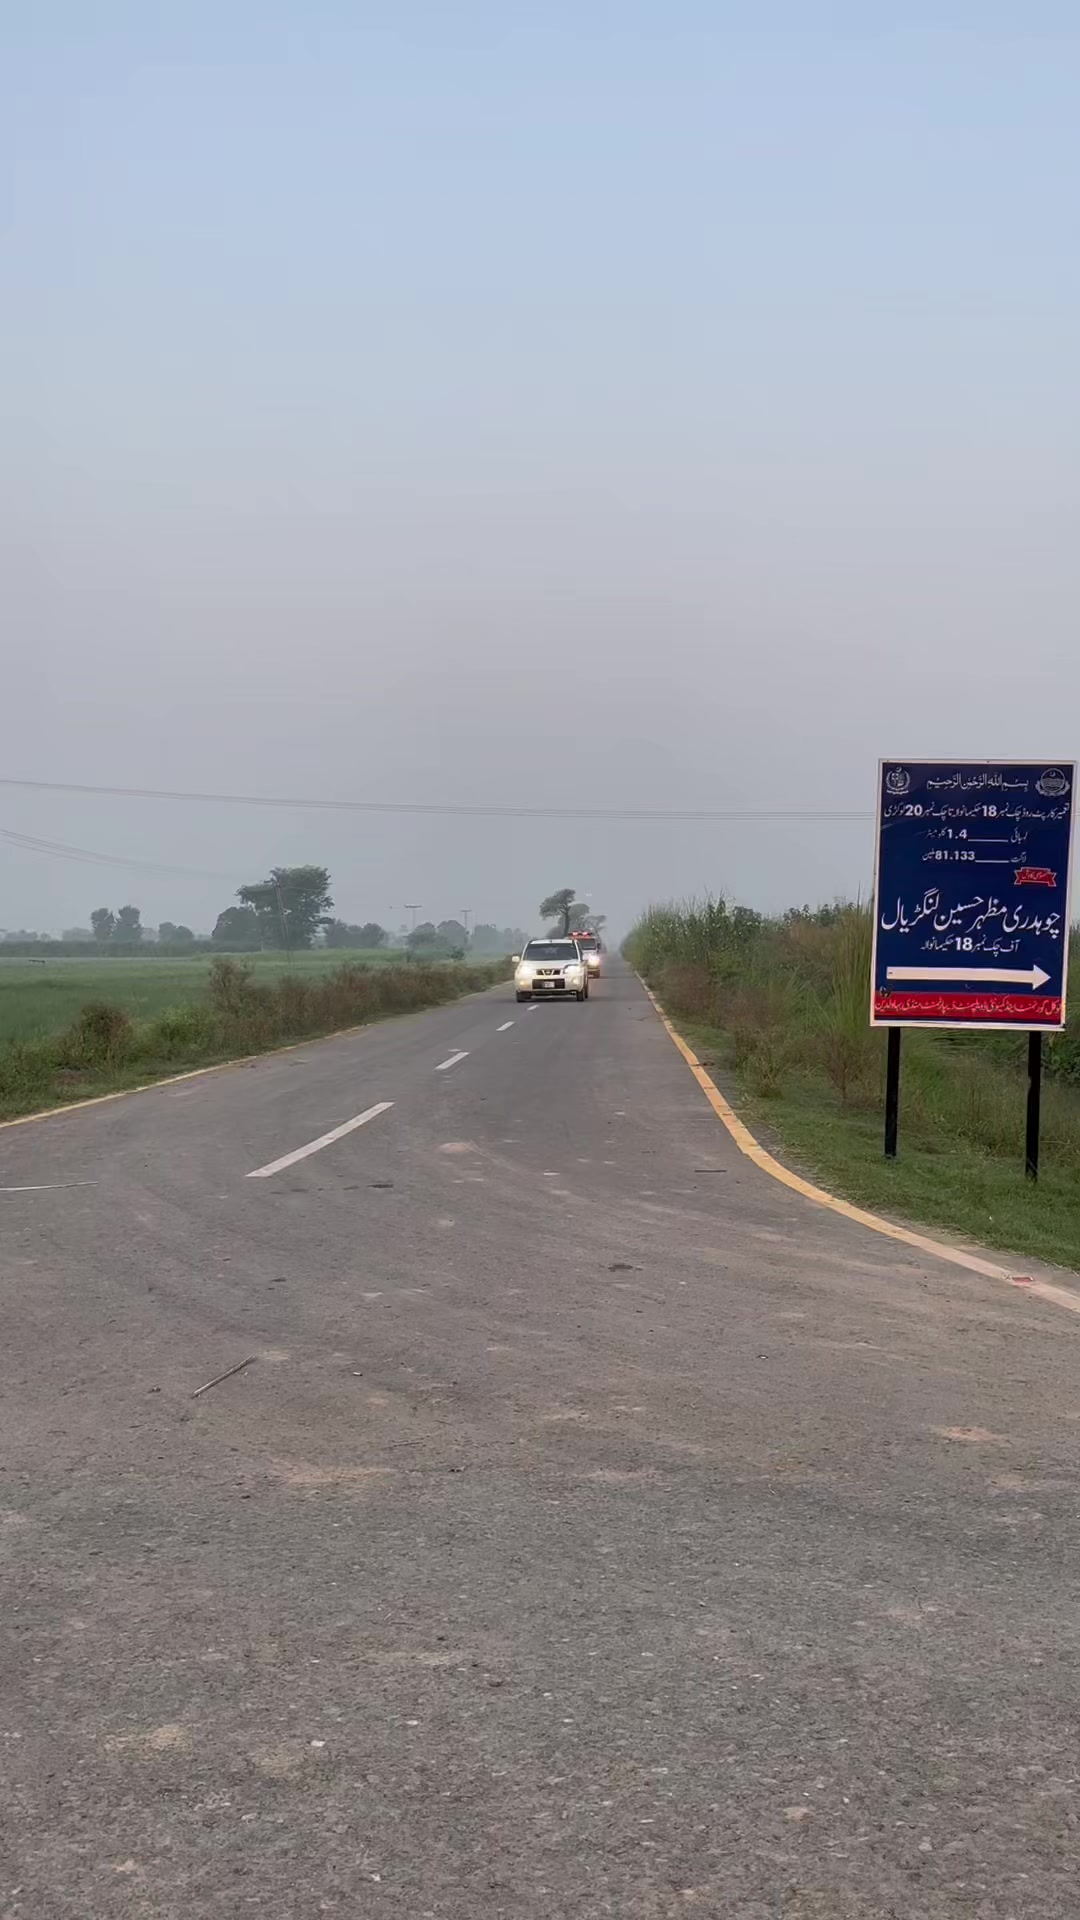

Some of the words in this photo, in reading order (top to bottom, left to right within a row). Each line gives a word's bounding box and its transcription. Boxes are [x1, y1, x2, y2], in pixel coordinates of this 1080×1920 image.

[905, 804, 923, 816] 20
[920, 801, 936, 818] نمبر
[932, 803, 949, 821] چک
[982, 805, 997, 817] 18
[995, 802, 1010, 819] نمبر
[1006, 804, 1023, 822] چک
[947, 829, 968, 839] 1.4
[935, 850, 976, 861] 81.133
[881, 887, 941, 933] لنگڑیال
[933, 896, 984, 931] حسین
[965, 896, 1008, 934] مظہر
[1002, 904, 1061, 939] چوہدری
[955, 937, 973, 951] 18
[971, 934, 988, 953] نمبر
[984, 936, 1003, 957] چک
[1000, 938, 1021, 952] آف
